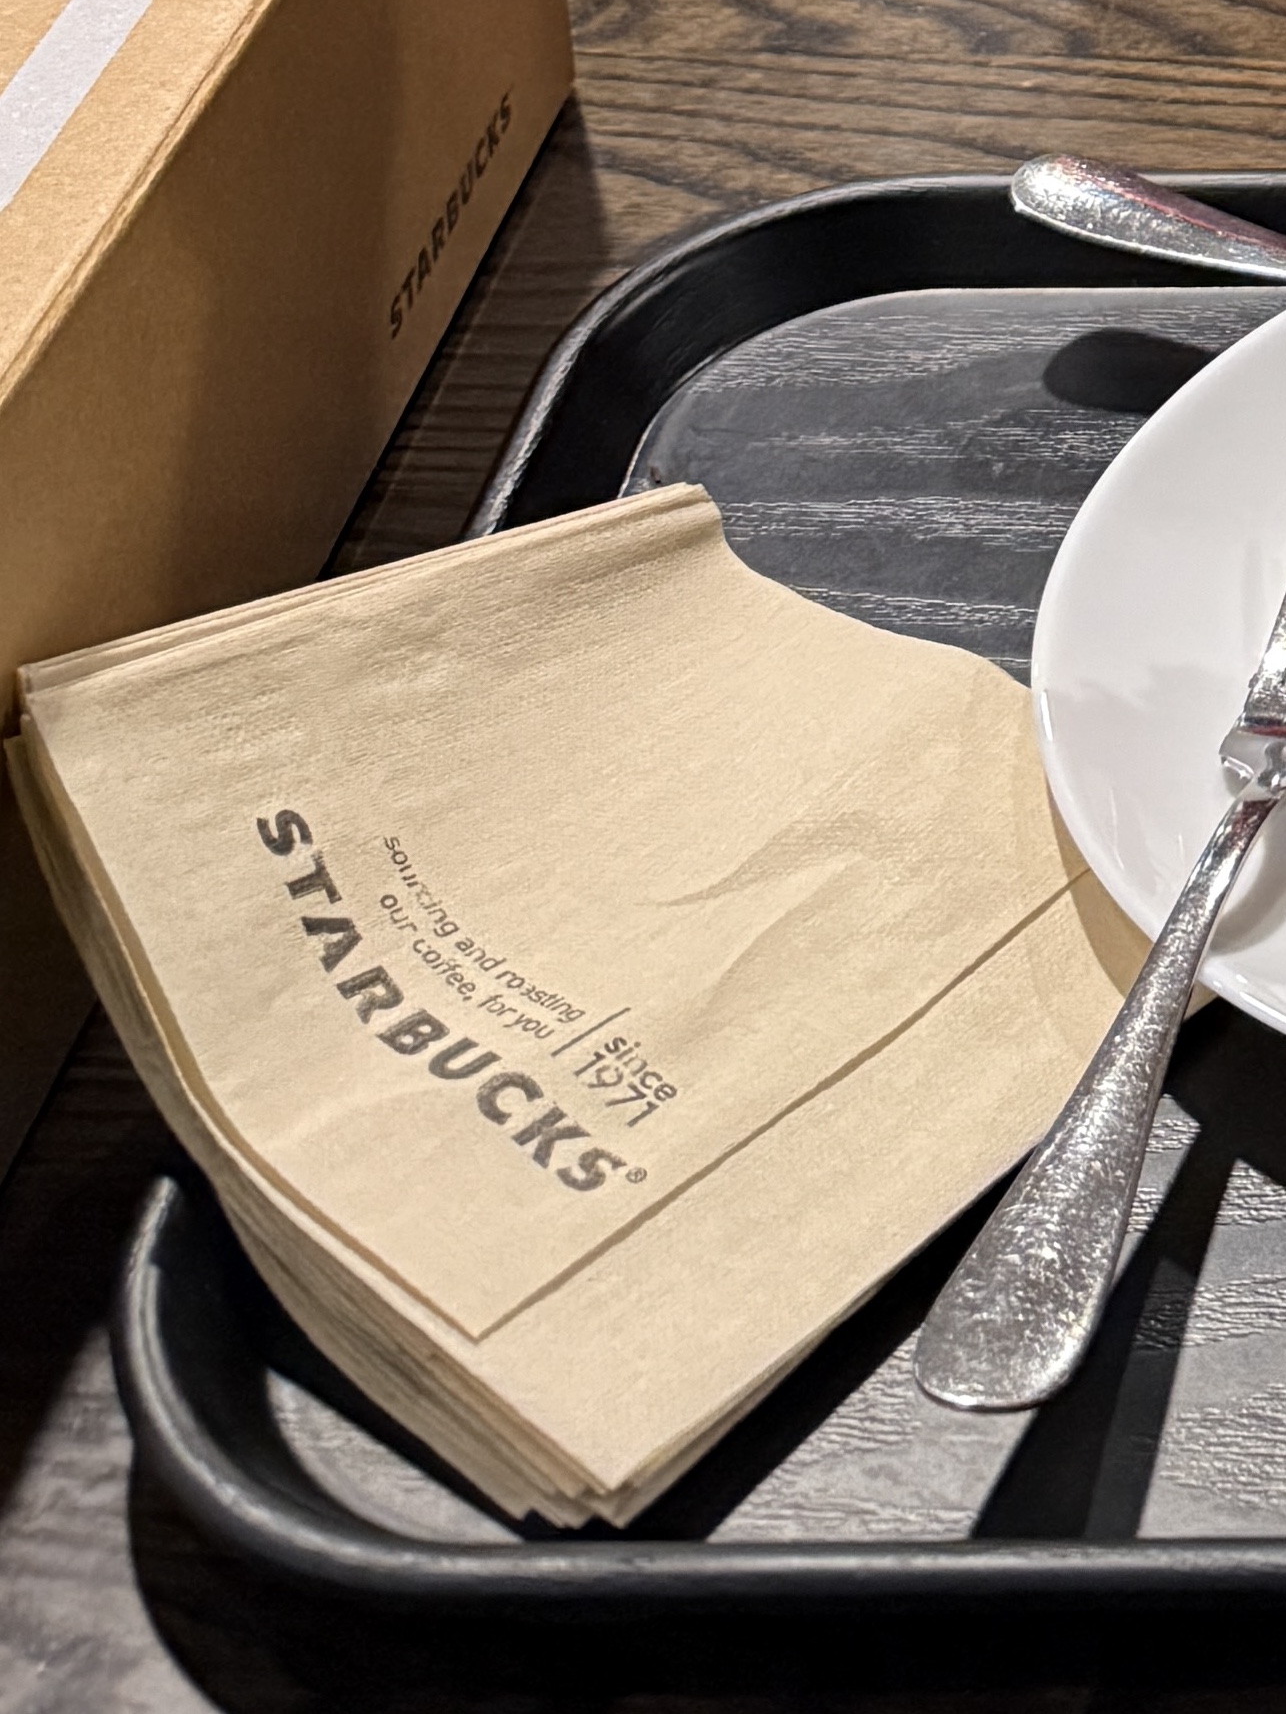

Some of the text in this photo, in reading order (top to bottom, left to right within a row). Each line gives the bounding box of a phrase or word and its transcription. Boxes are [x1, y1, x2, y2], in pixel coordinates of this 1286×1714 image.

[389, 89, 513, 340] STARBUCKS
[379, 893, 418, 932] our
[476, 993, 518, 1017] for
[502, 1012, 555, 1040] you
[383, 835, 586, 1024] sourcing and roasting
[573, 1050, 660, 1128] 1971
[603, 1036, 678, 1103] since
